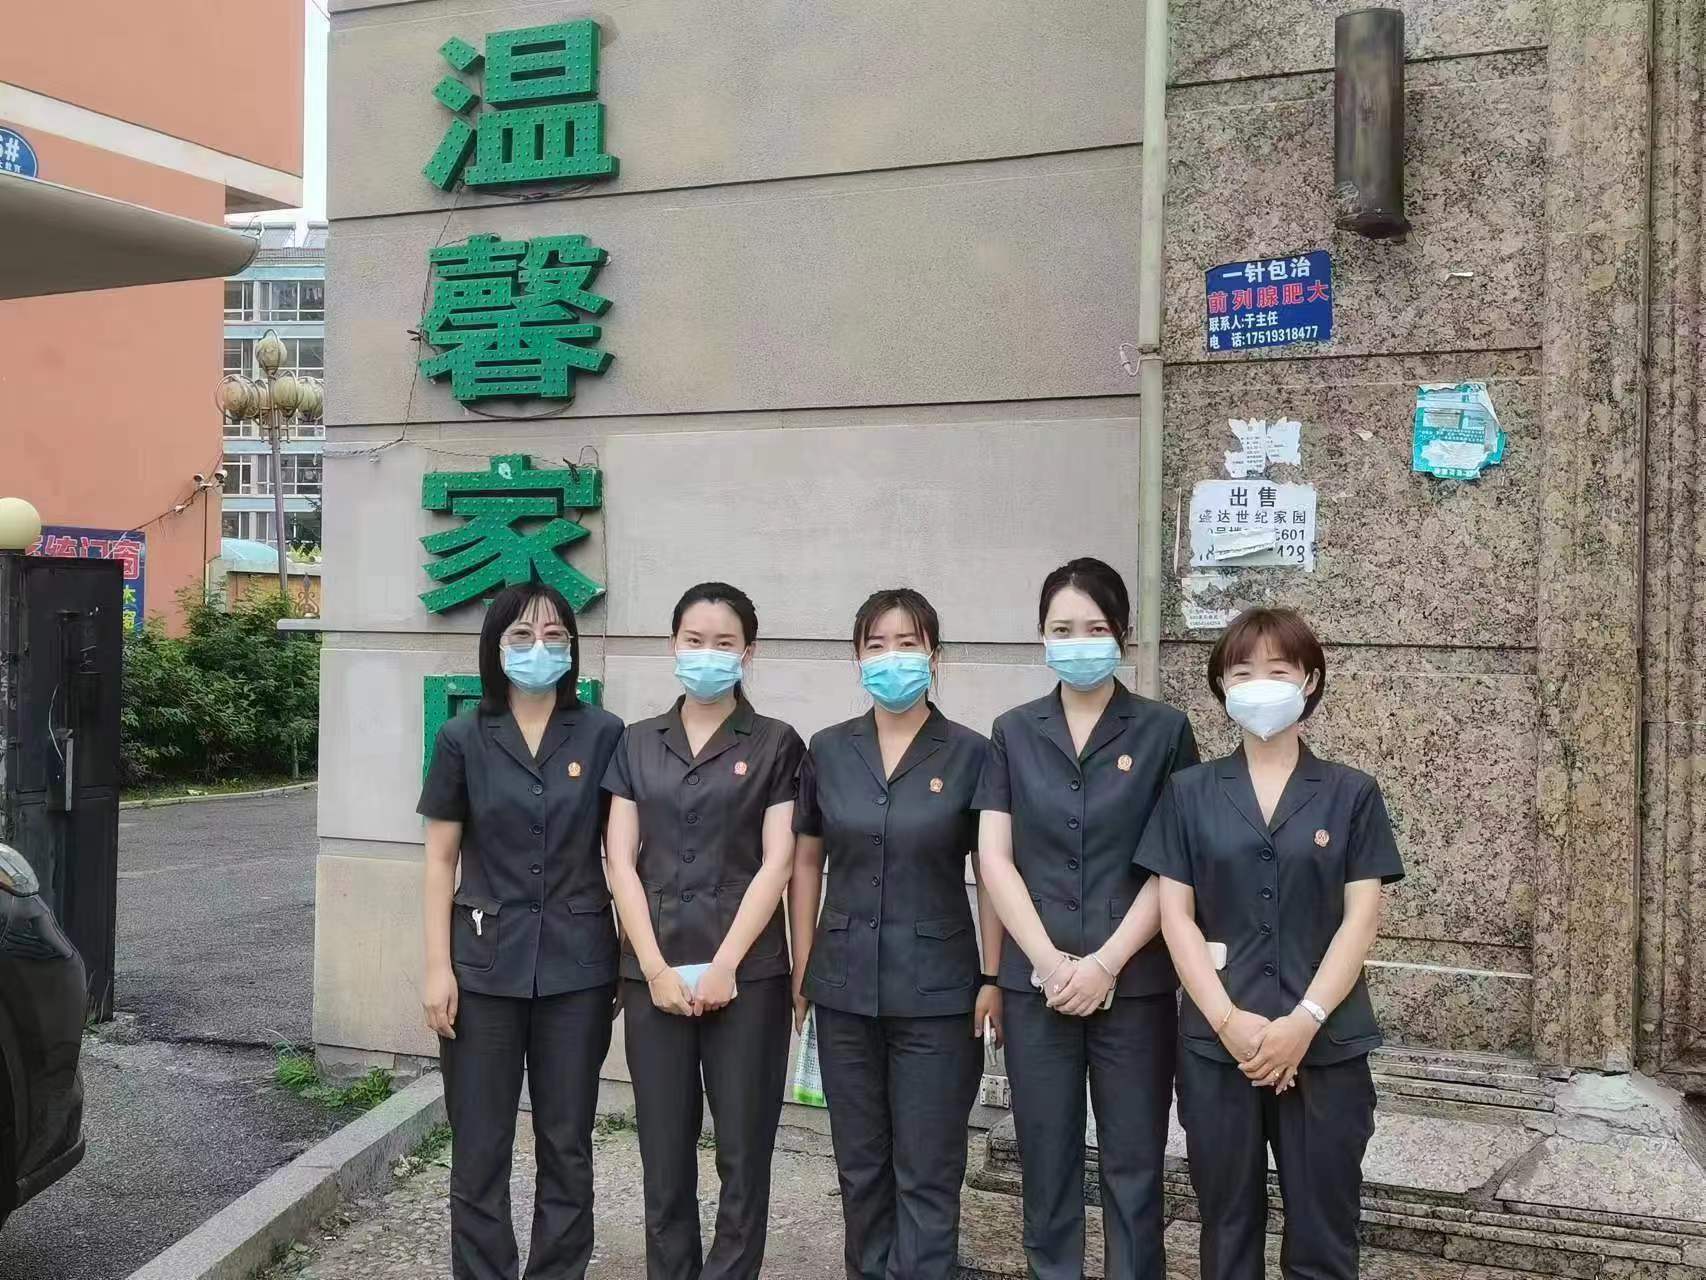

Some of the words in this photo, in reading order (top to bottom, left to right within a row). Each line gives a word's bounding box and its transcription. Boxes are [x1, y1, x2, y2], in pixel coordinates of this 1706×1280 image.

[1222, 256, 1312, 283] 一针包治
[1207, 279, 1330, 314] 前列腺肥大
[420, 19, 620, 782] 温馨家
[1229, 486, 1278, 508] 出售
[1198, 509, 1307, 524] 盛达世纪家园
